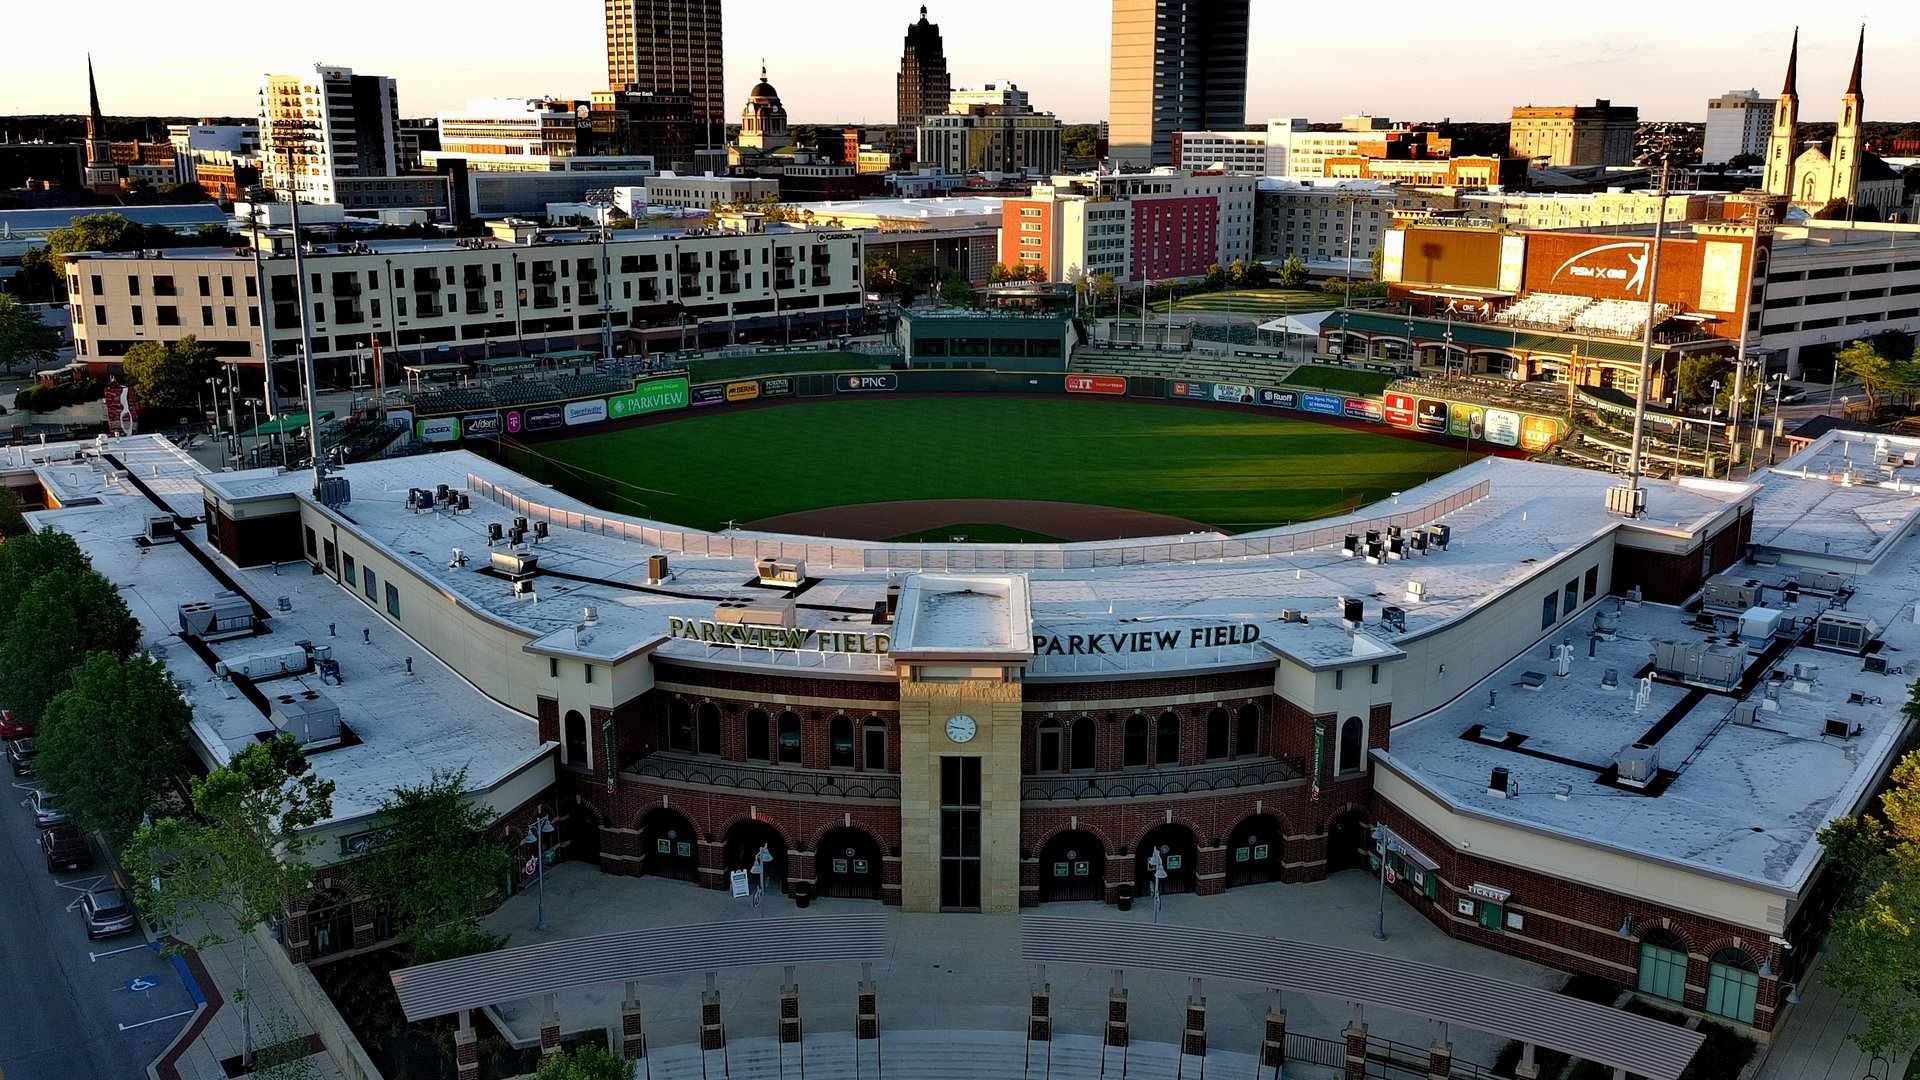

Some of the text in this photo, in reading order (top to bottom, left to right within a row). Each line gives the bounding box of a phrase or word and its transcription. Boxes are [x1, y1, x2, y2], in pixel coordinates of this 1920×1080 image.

[861, 377, 887, 387] PNC
[1079, 379, 1093, 389] IT
[628, 392, 683, 411] PARKVIEW
[1273, 392, 1293, 401] Ruoff
[569, 405, 602, 416] Sweetwater
[1643, 414, 1674, 425] PAVILION
[425, 425, 452, 435] ESSEX
[669, 616, 891, 654] PARKVIEW FIELD
[1032, 623, 1261, 656] PARKVIEW FIELD
[1467, 885, 1505, 901] TICKETS
